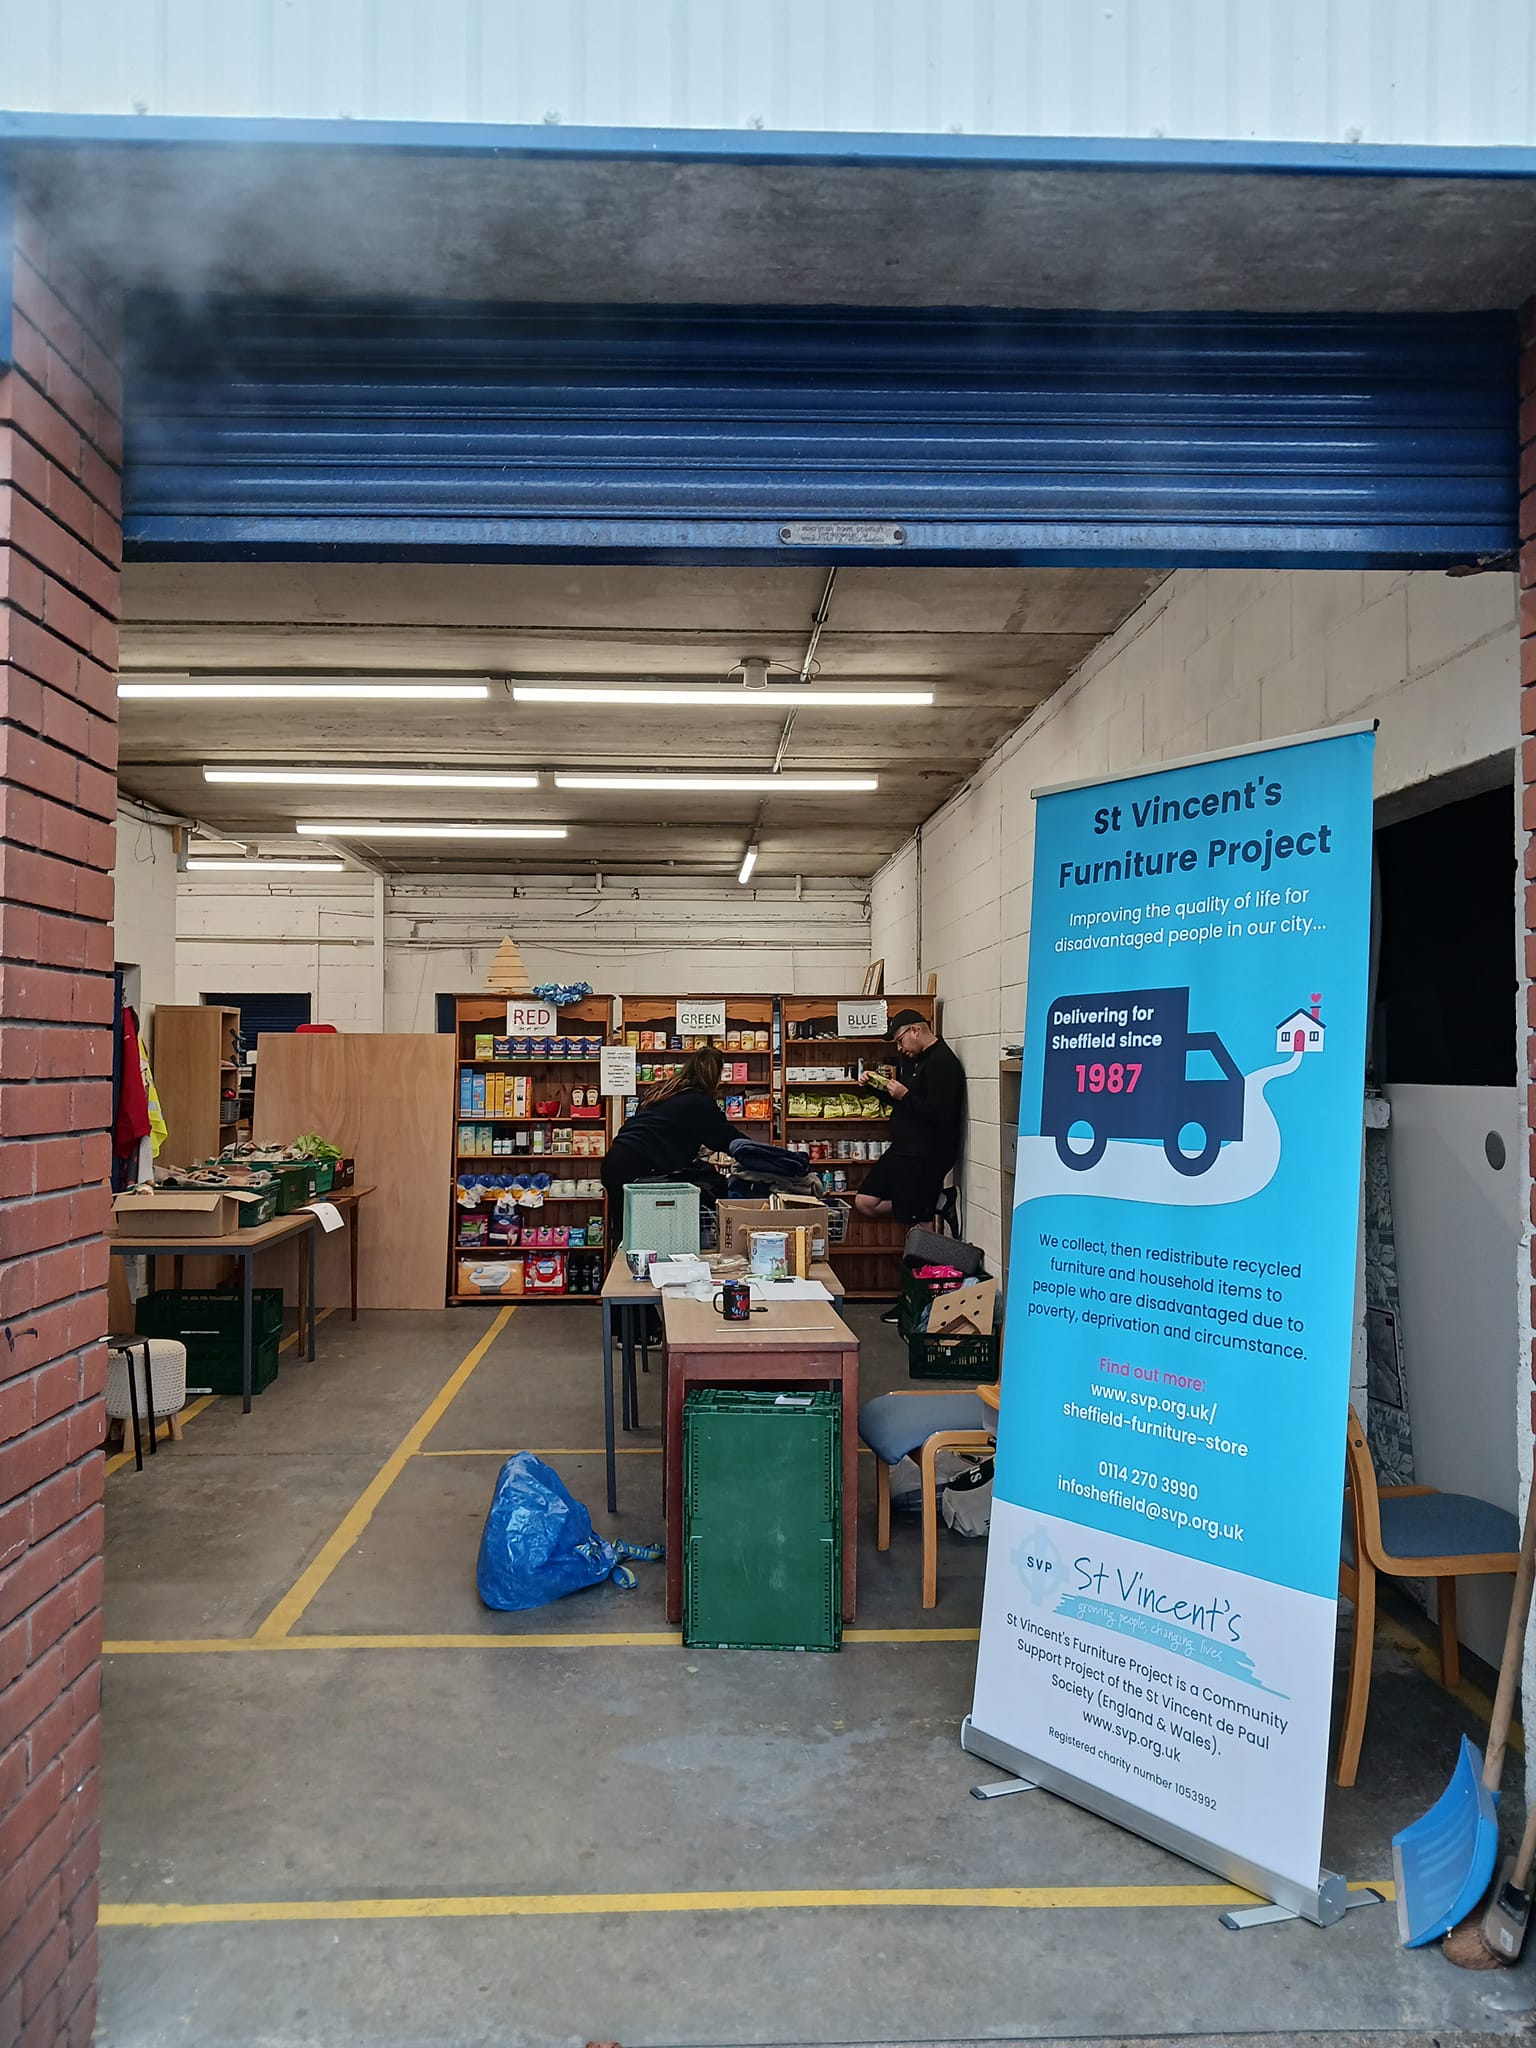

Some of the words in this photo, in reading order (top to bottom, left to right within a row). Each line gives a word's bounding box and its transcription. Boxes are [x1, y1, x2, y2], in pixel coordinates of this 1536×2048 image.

[1094, 806, 1121, 834] St
[1132, 776, 1282, 828] Vincent's
[1059, 849, 1198, 888] Furniture
[1208, 824, 1332, 871] Project
[1069, 906, 1141, 927] Improving
[1145, 903, 1171, 919] the
[1175, 896, 1230, 920] quality
[1234, 891, 1253, 909] of
[1255, 890, 1281, 907] life
[1285, 887, 1309, 904] for
[1055, 929, 1164, 952] disadvantaged
[1168, 924, 1223, 946] people
[1227, 921, 1242, 937] in
[1247, 919, 1275, 934] our
[1280, 915, 1327, 936] city...
[514, 1009, 551, 1025] RED
[681, 1013, 721, 1025] GREEN
[848, 1014, 878, 1025] BLUE
[1054, 1007, 1128, 1026] Delivering
[1132, 1005, 1154, 1021] for
[1052, 1033, 1116, 1049] Sheffield
[1120, 1031, 1162, 1047] since
[1076, 1063, 1142, 1093] 1987
[1039, 1233, 1058, 1248] We
[1061, 1237, 1107, 1256] collect,
[1111, 1242, 1141, 1258] then
[1146, 1248, 1228, 1269] redistribute
[1233, 1258, 1301, 1279] recycled
[1050, 1257, 1105, 1277] furniture
[1108, 1268, 1136, 1282] and
[1140, 1269, 1214, 1294] household
[1218, 1280, 1262, 1300] items
[1267, 1287, 1282, 1302] to
[1033, 1279, 1076, 1298] people
[1080, 1286, 1106, 1301] who
[1109, 1291, 1132, 1305] are
[1136, 1295, 1248, 1325] disadvantaged
[1252, 1312, 1283, 1329] due
[1288, 1316, 1304, 1333] to
[1028, 1302, 1079, 1324] poverty,
[1082, 1310, 1160, 1335] deprivation
[1163, 1324, 1191, 1341] and
[1194, 1329, 1308, 1361] circumstance.
[1099, 1358, 1130, 1377] Find
[1133, 1366, 1159, 1382] out
[1163, 1373, 1206, 1392] more:
[1091, 1383, 1218, 1425] www.svp.org.uk/
[1063, 1402, 1249, 1457] sheffield-furniture-store
[1099, 1461, 1128, 1482] 0114
[1131, 1469, 1158, 1489] 270
[1161, 1476, 1199, 1500] 3990
[1057, 1474, 1245, 1542] infosheffield@svp.org.uk
[1027, 1556, 1053, 1573] SVP
[1074, 1557, 1110, 1595] St
[1116, 1568, 1242, 1642] Vincent's
[1076, 1601, 1116, 1627] growing
[1150, 1624, 1193, 1657] changing
[1200, 1639, 1223, 1662] lives
[1006, 1612, 1018, 1627] St
[1020, 1617, 1071, 1647] Vincent's
[1073, 1637, 1126, 1668] Furniture
[1129, 1658, 1173, 1687] Project
[1176, 1675, 1187, 1692] is
[1190, 1684, 1199, 1696] a
[1202, 1687, 1288, 1735] Community
[1017, 1638, 1062, 1666] Support
[1064, 1656, 1105, 1683] Project
[1107, 1675, 1120, 1689] of
[1122, 1680, 1143, 1698] the
[1146, 1688, 1159, 1705] St
[1162, 1694, 1213, 1727] Vincent
[1216, 1718, 1234, 1735] de
[1238, 1726, 1269, 1750] Paul
[1051, 1674, 1094, 1704] Society
[1097, 1689, 1153, 1726] (England
[1157, 1717, 1166, 1732] &
[1170, 1721, 1221, 1755] Wales).
[1083, 1711, 1181, 1762] www.svp.org.uk
[1049, 1726, 1096, 1755] Registered
[1098, 1750, 1131, 1773] charity
[1134, 1766, 1172, 1790] number
[1175, 1783, 1217, 1811] 1053992
